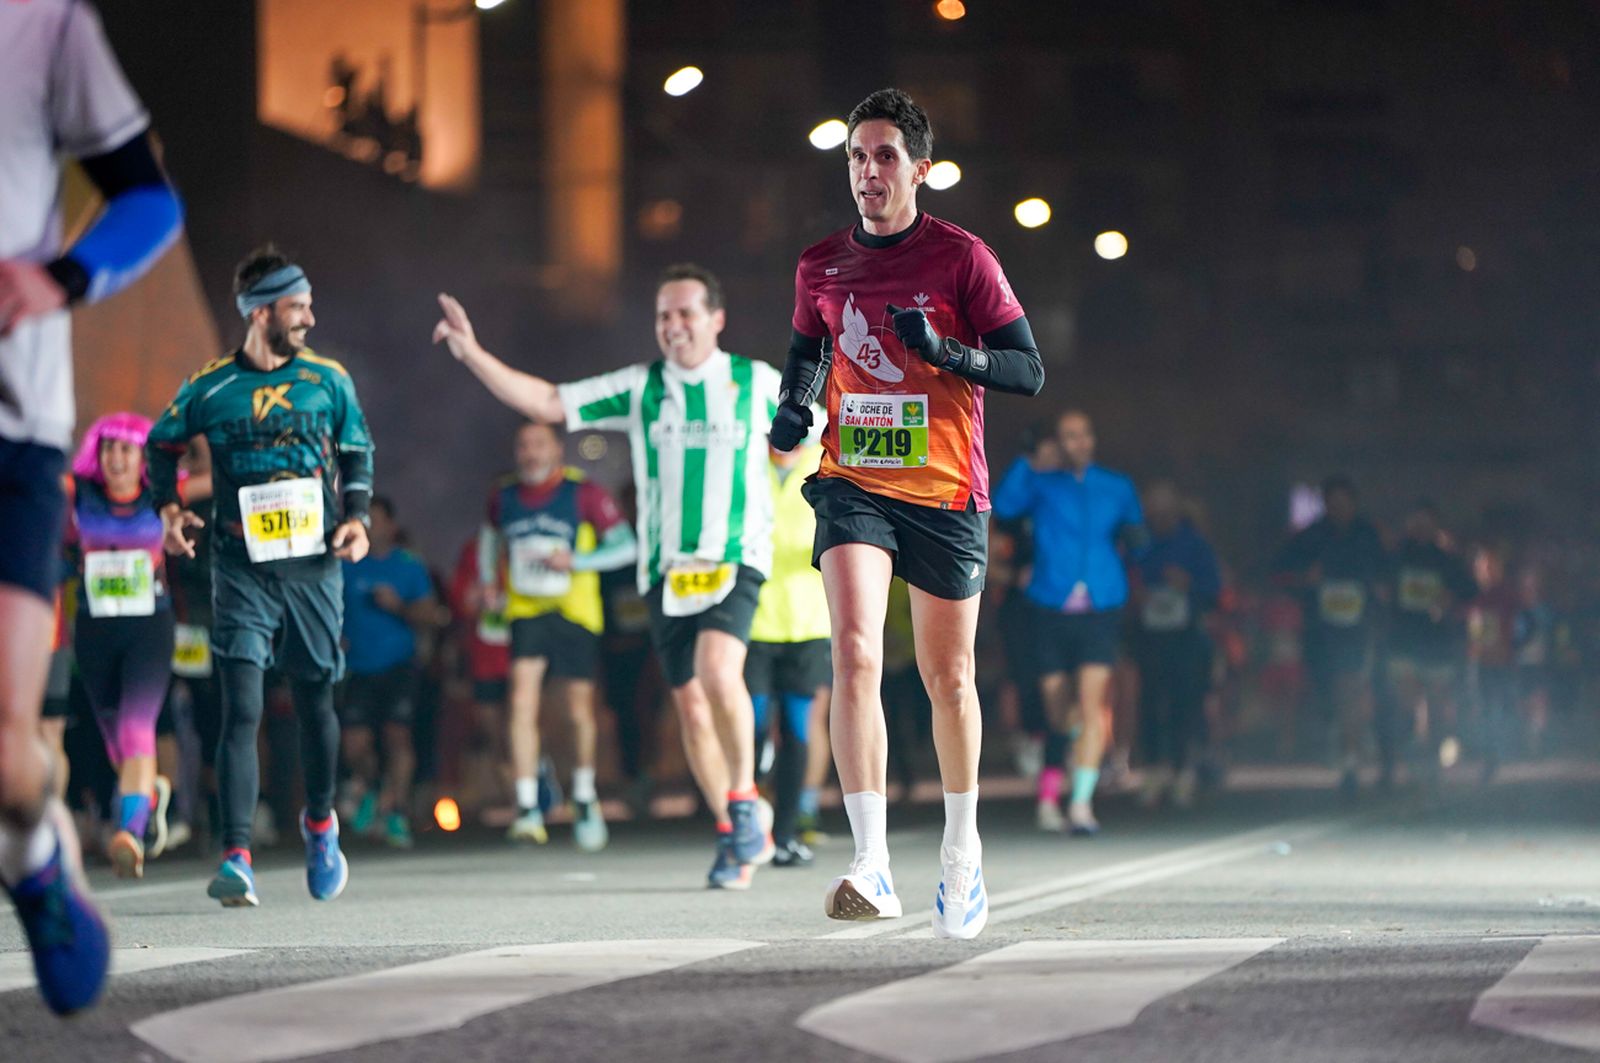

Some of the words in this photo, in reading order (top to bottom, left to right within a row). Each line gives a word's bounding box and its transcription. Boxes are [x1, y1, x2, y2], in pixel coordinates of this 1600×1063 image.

[856, 343, 881, 370] 43
[882, 405, 893, 415] DE
[845, 415, 861, 426] SAN
[853, 427, 912, 457] 9219
